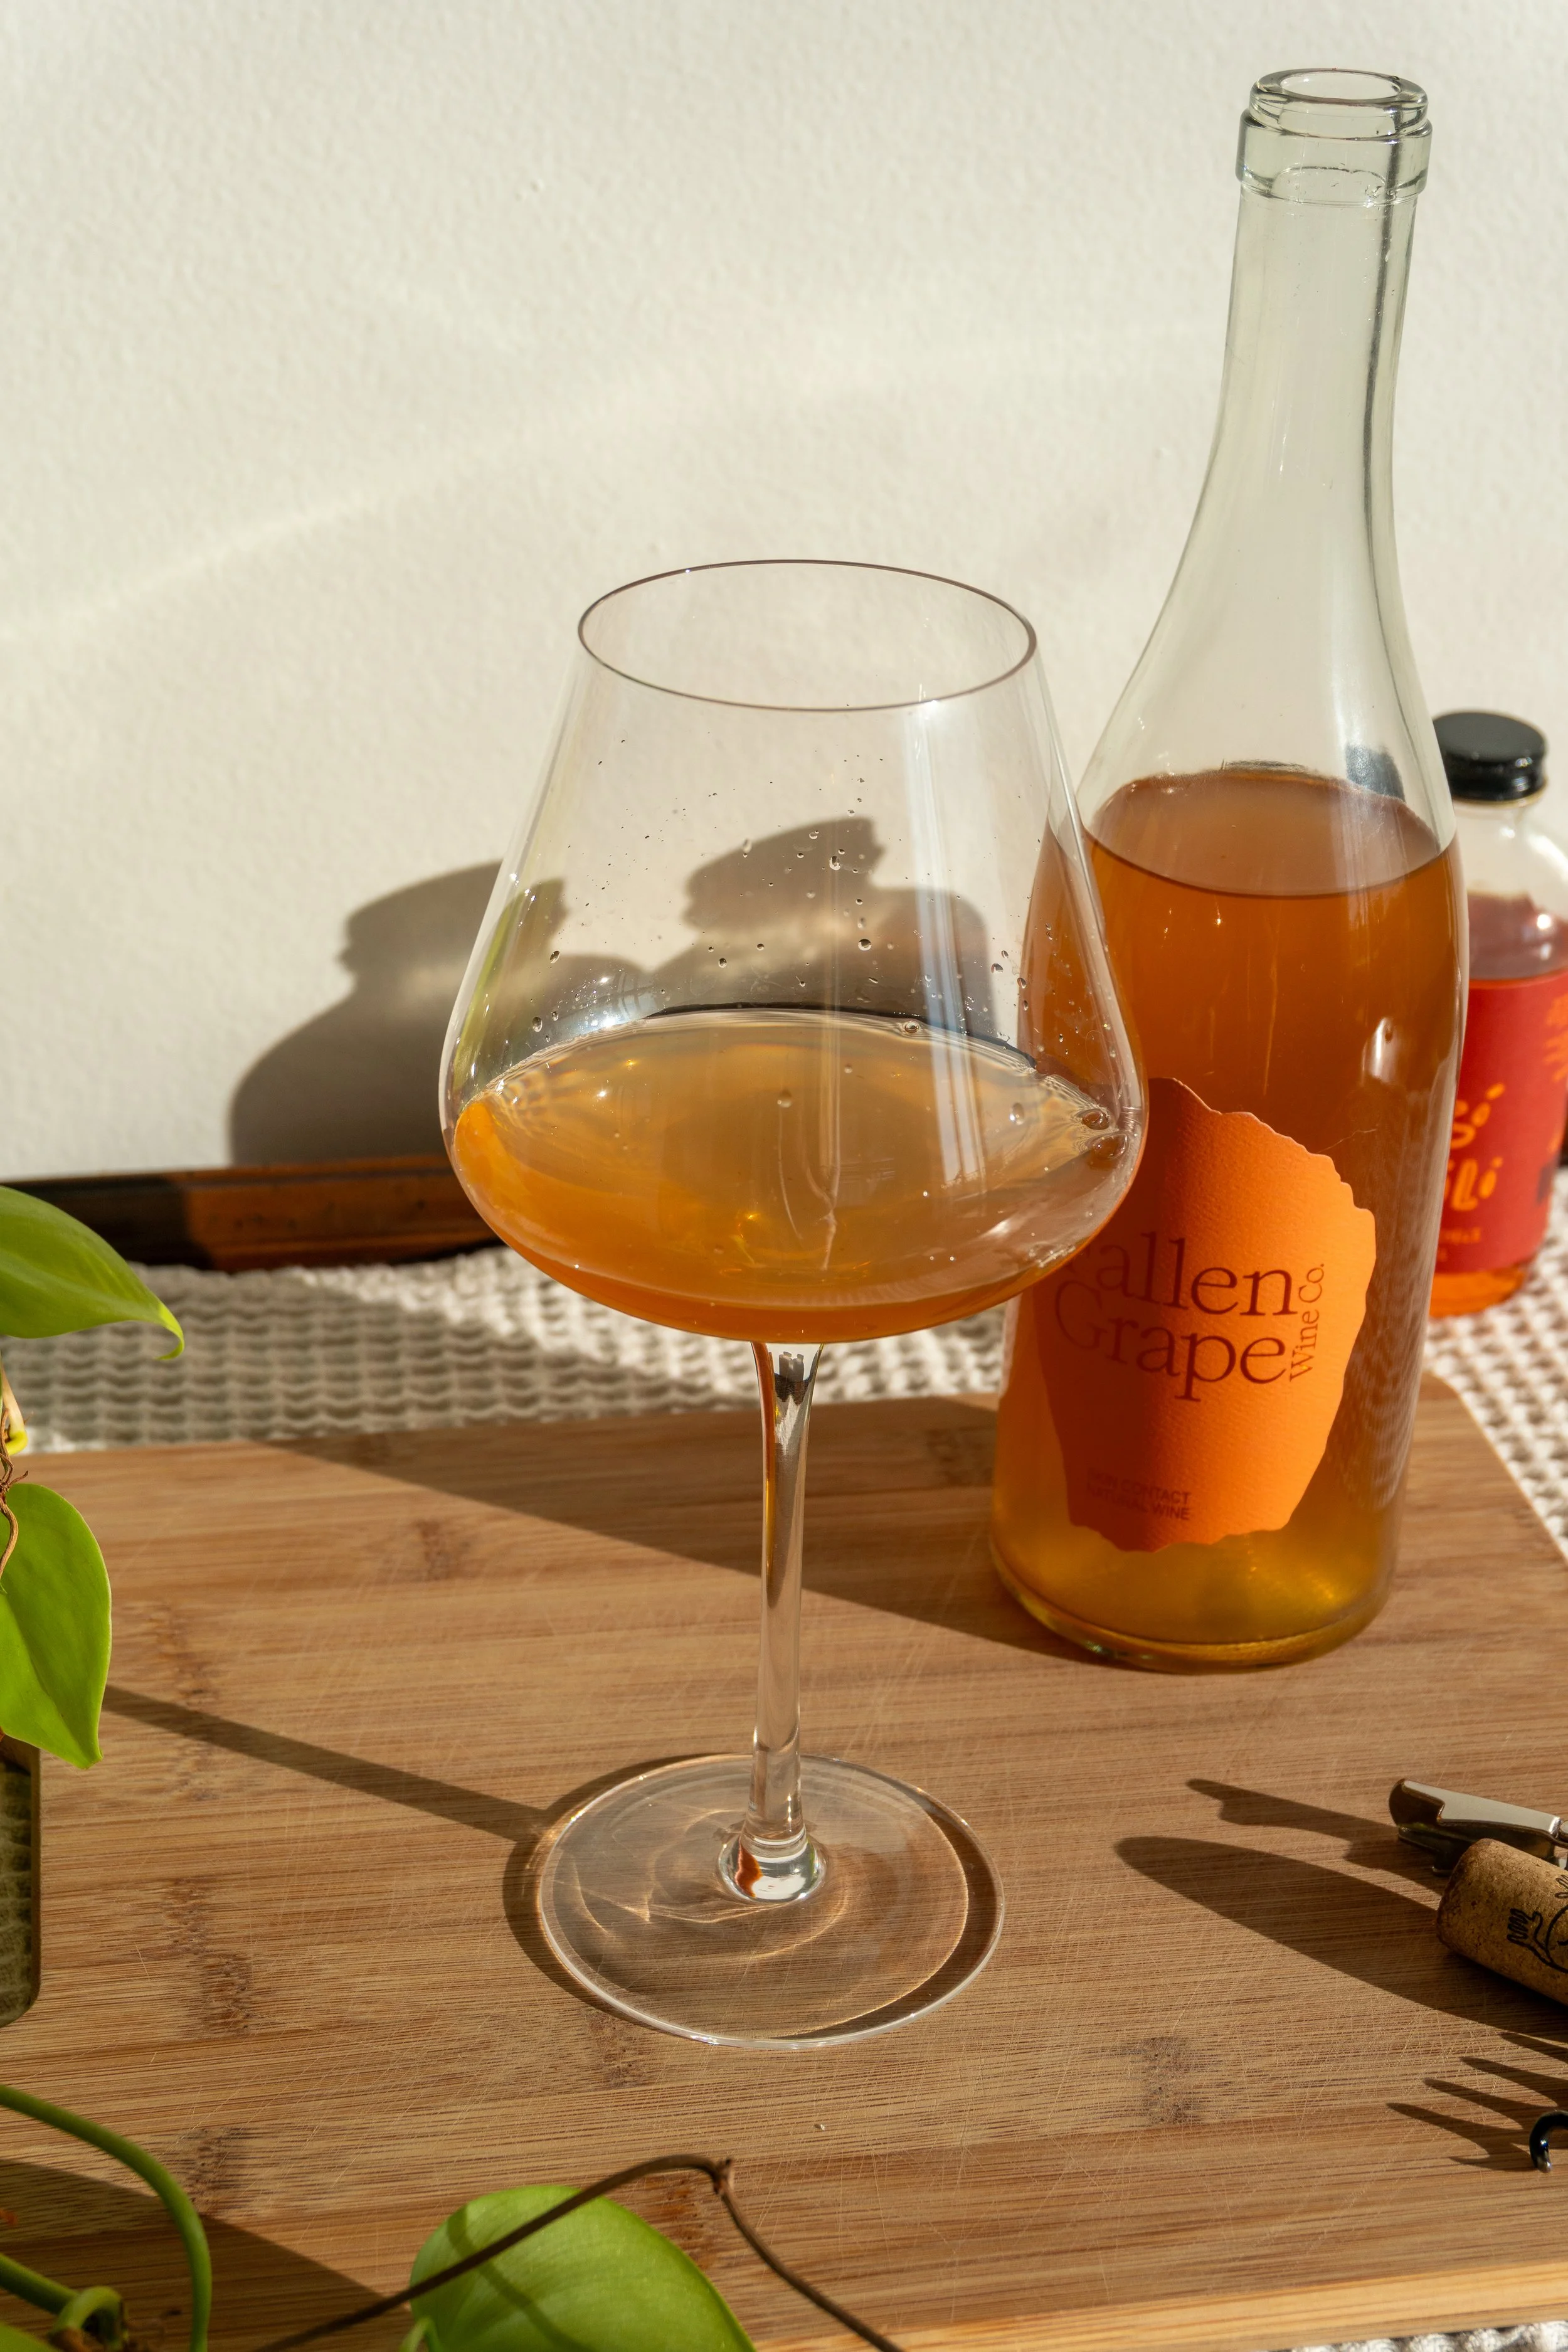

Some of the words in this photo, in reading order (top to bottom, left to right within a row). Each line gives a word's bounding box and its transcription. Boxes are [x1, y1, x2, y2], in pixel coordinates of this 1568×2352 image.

[1065, 1231, 1298, 1316] allen
[1298, 1263, 1325, 1304] Co.
[1055, 1279, 1287, 1402] Grape
[1290, 1308, 1320, 1382] Wine
[1120, 1479, 1192, 1505] CONTACT
[1152, 1503, 1191, 1521] WINE
